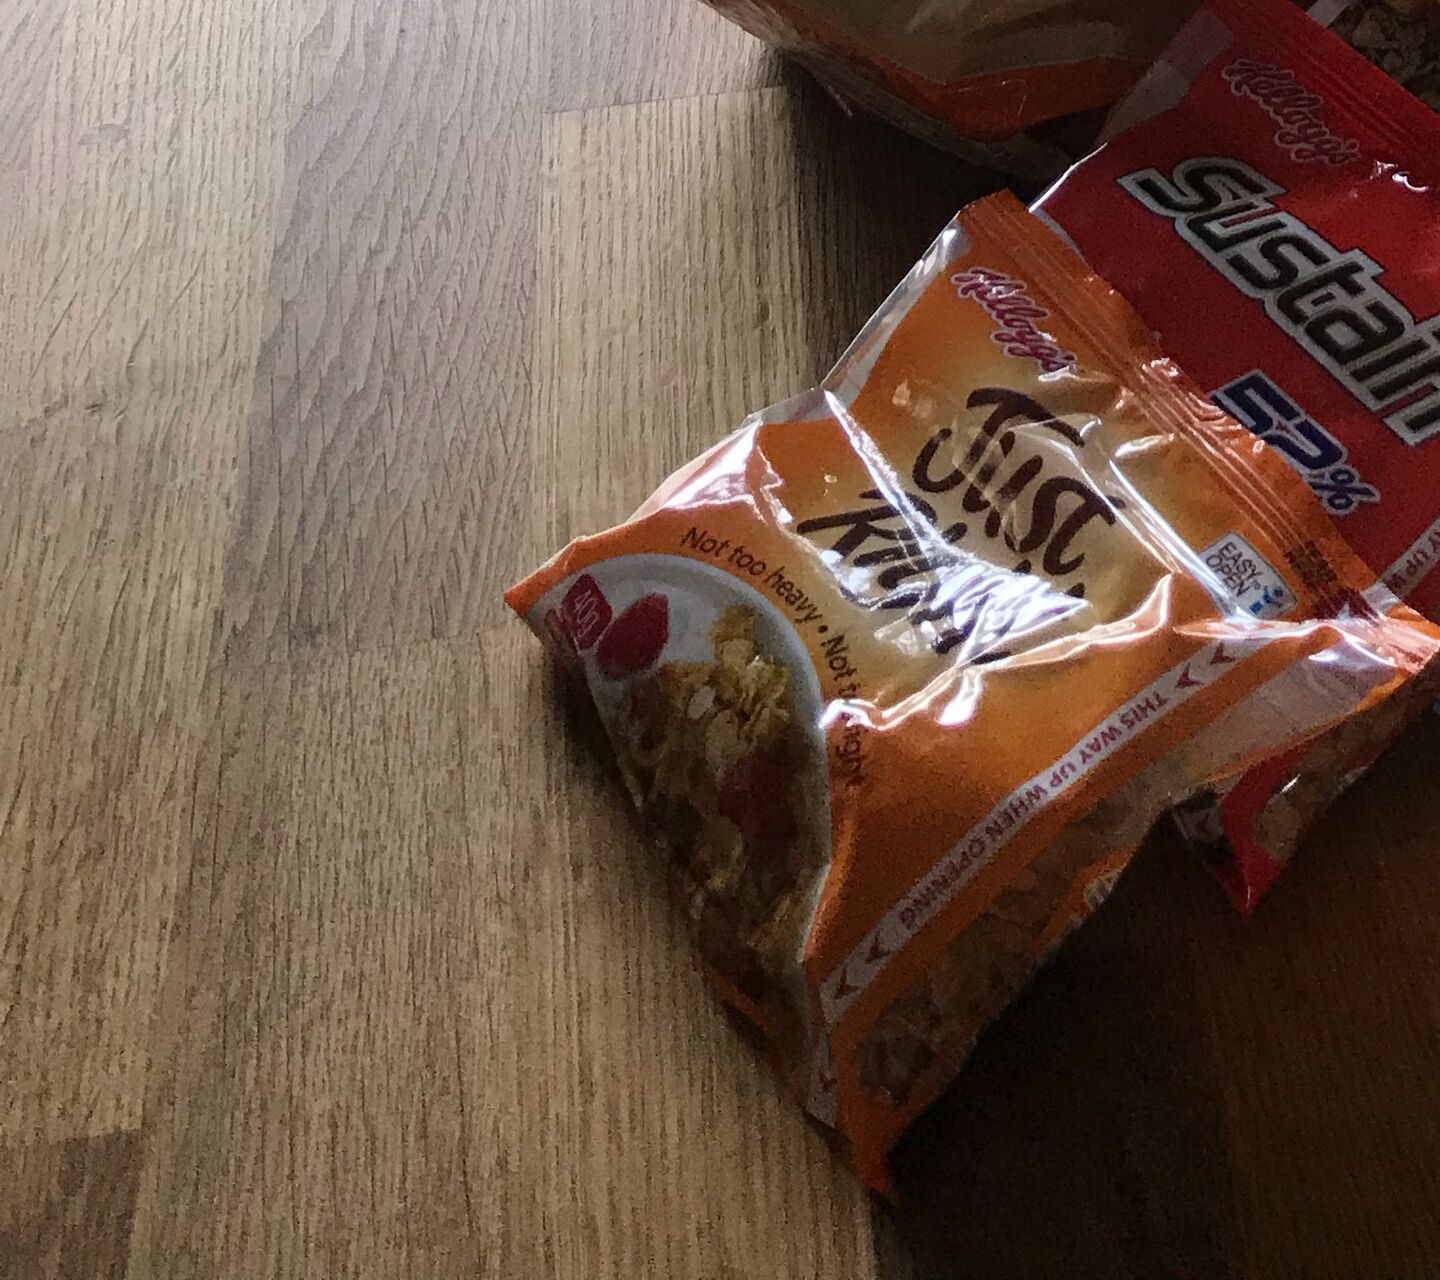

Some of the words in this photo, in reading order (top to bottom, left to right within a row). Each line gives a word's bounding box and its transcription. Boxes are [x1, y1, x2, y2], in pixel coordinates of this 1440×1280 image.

[1205, 554, 1252, 597] OPEN
[1218, 541, 1264, 581] EASY
[1406, 548, 1430, 576] UP
[680, 526, 730, 558] Not
[732, 542, 767, 577] too
[763, 565, 824, 625] heavy
[818, 633, 860, 682] Not
[1120, 689, 1170, 730] THIS
[1078, 724, 1123, 765] WAY
[1050, 761, 1077, 789] UP
[985, 784, 1049, 842] WHEN
[899, 837, 986, 931] OPENING
